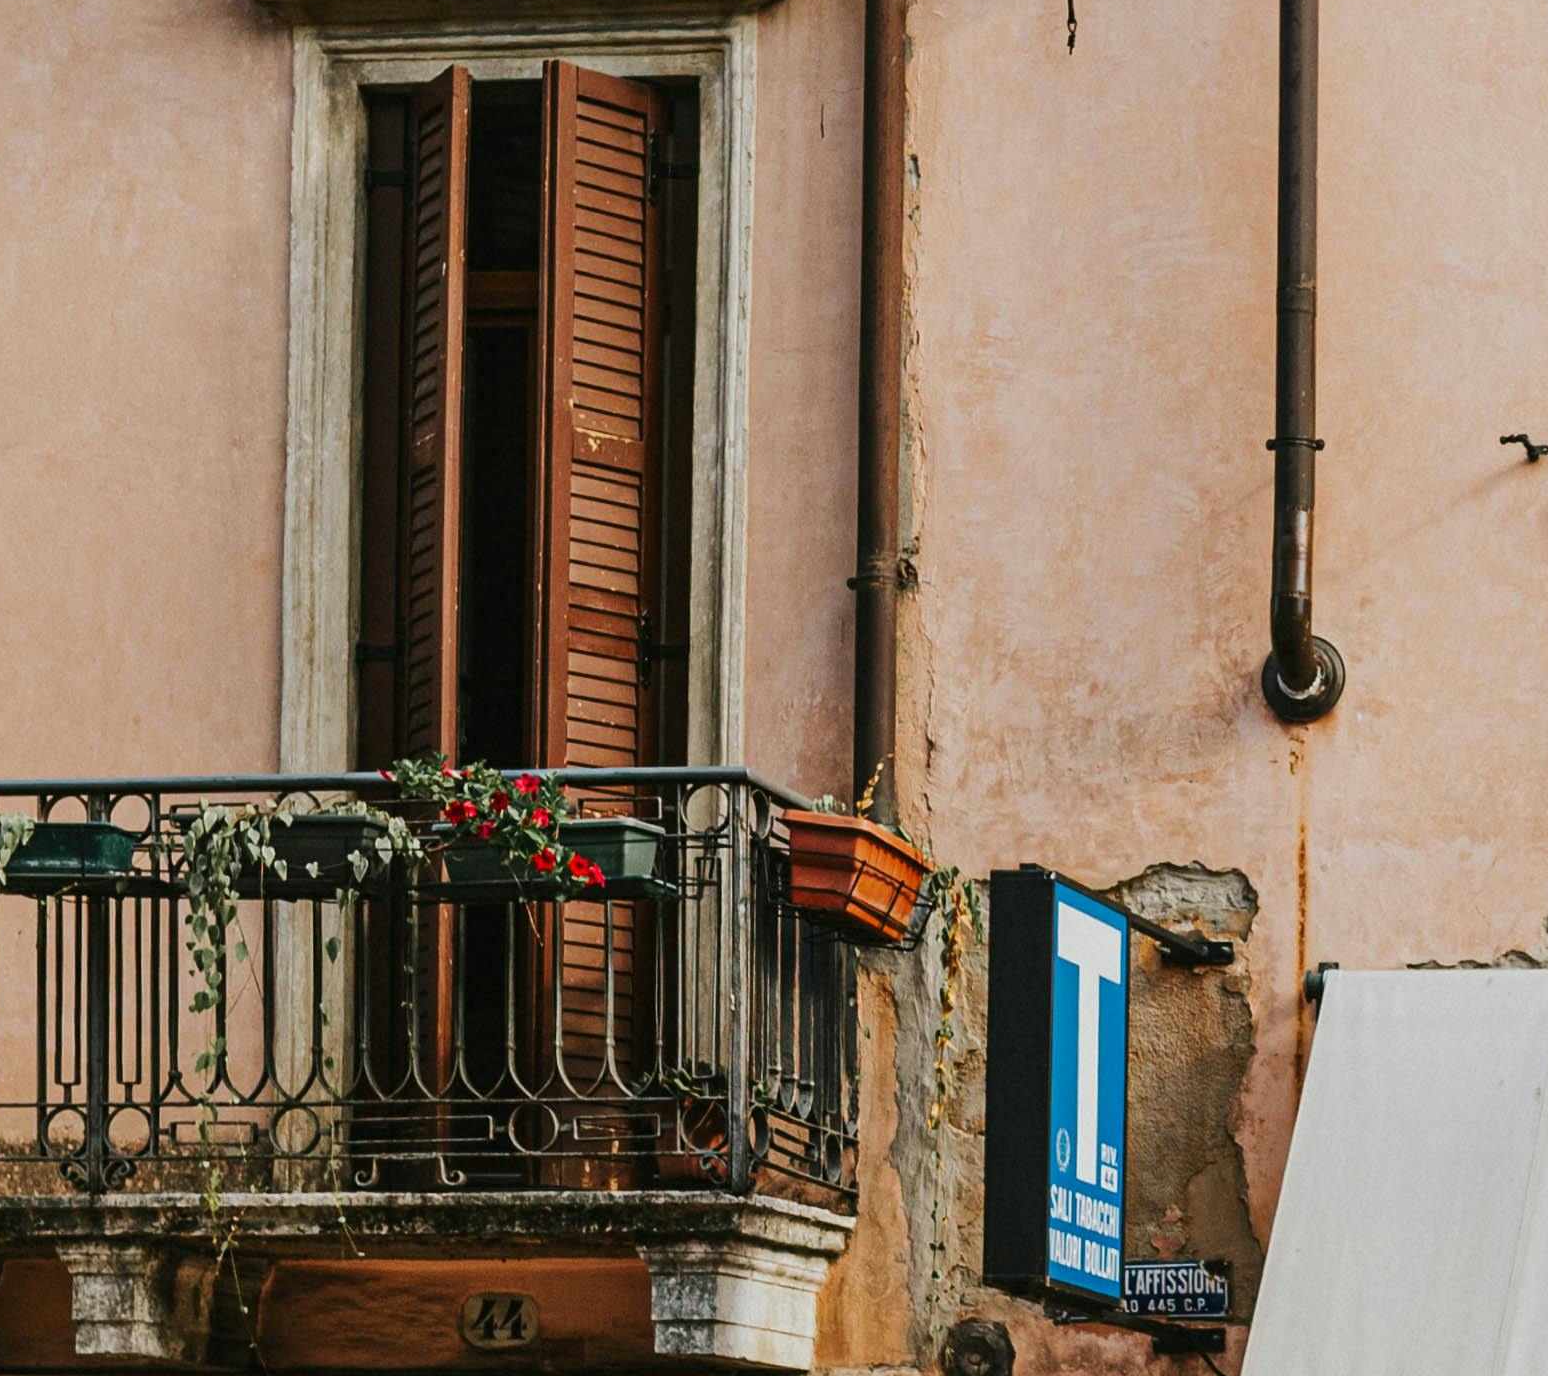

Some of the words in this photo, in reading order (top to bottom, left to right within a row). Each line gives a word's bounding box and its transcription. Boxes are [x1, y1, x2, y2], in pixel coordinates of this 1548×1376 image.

[1057, 900, 1122, 1185] T
[1050, 1184, 1072, 1224] SALI
[1075, 1192, 1119, 1239] TABACCHI
[1049, 1228, 1081, 1271] VALORI
[1084, 1239, 1119, 1282] BOLLATI
[470, 1298, 528, 1341] 44
[1148, 1298, 1176, 1312] 445
[1184, 1298, 1209, 1312] C.P.
